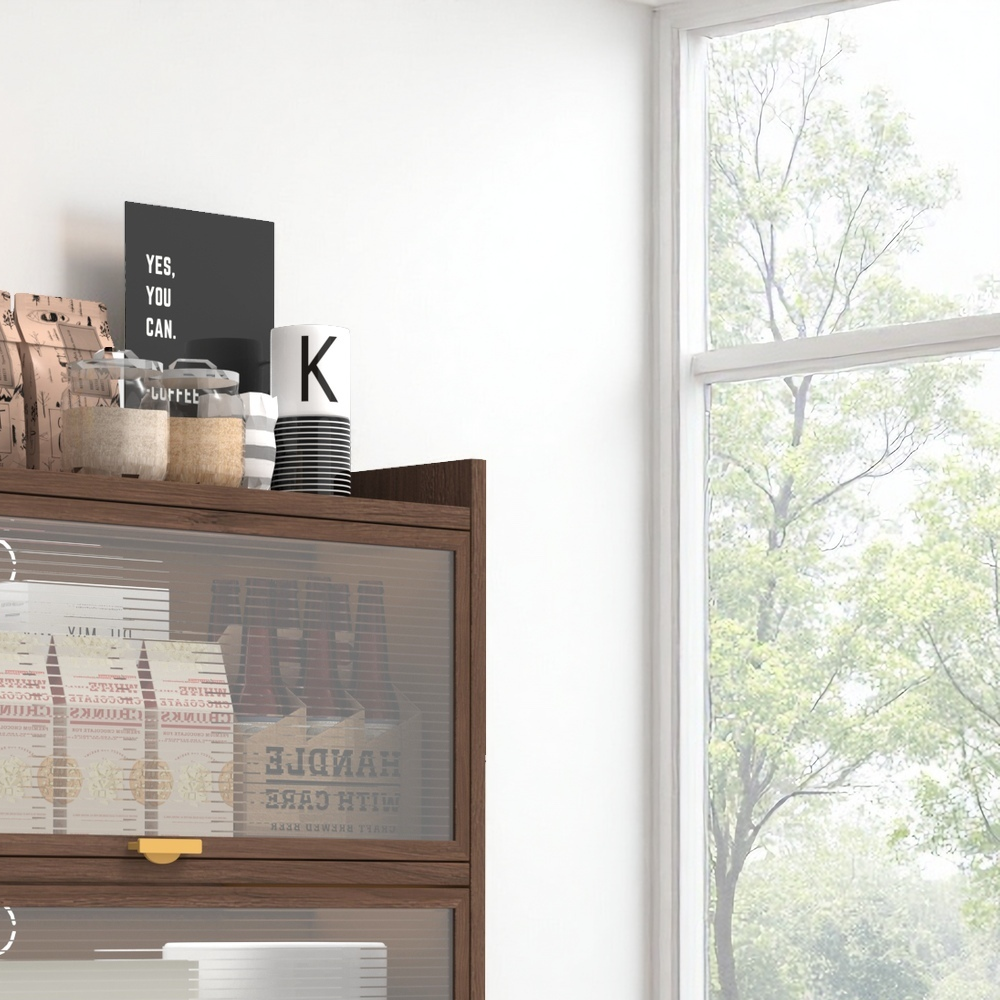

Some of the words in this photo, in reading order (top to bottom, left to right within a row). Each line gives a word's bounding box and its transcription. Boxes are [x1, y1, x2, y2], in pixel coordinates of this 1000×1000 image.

[145, 253, 176, 279] YES,
[145, 285, 172, 308] YOU
[145, 316, 177, 340] CAN.
[301, 335, 339, 403] K
